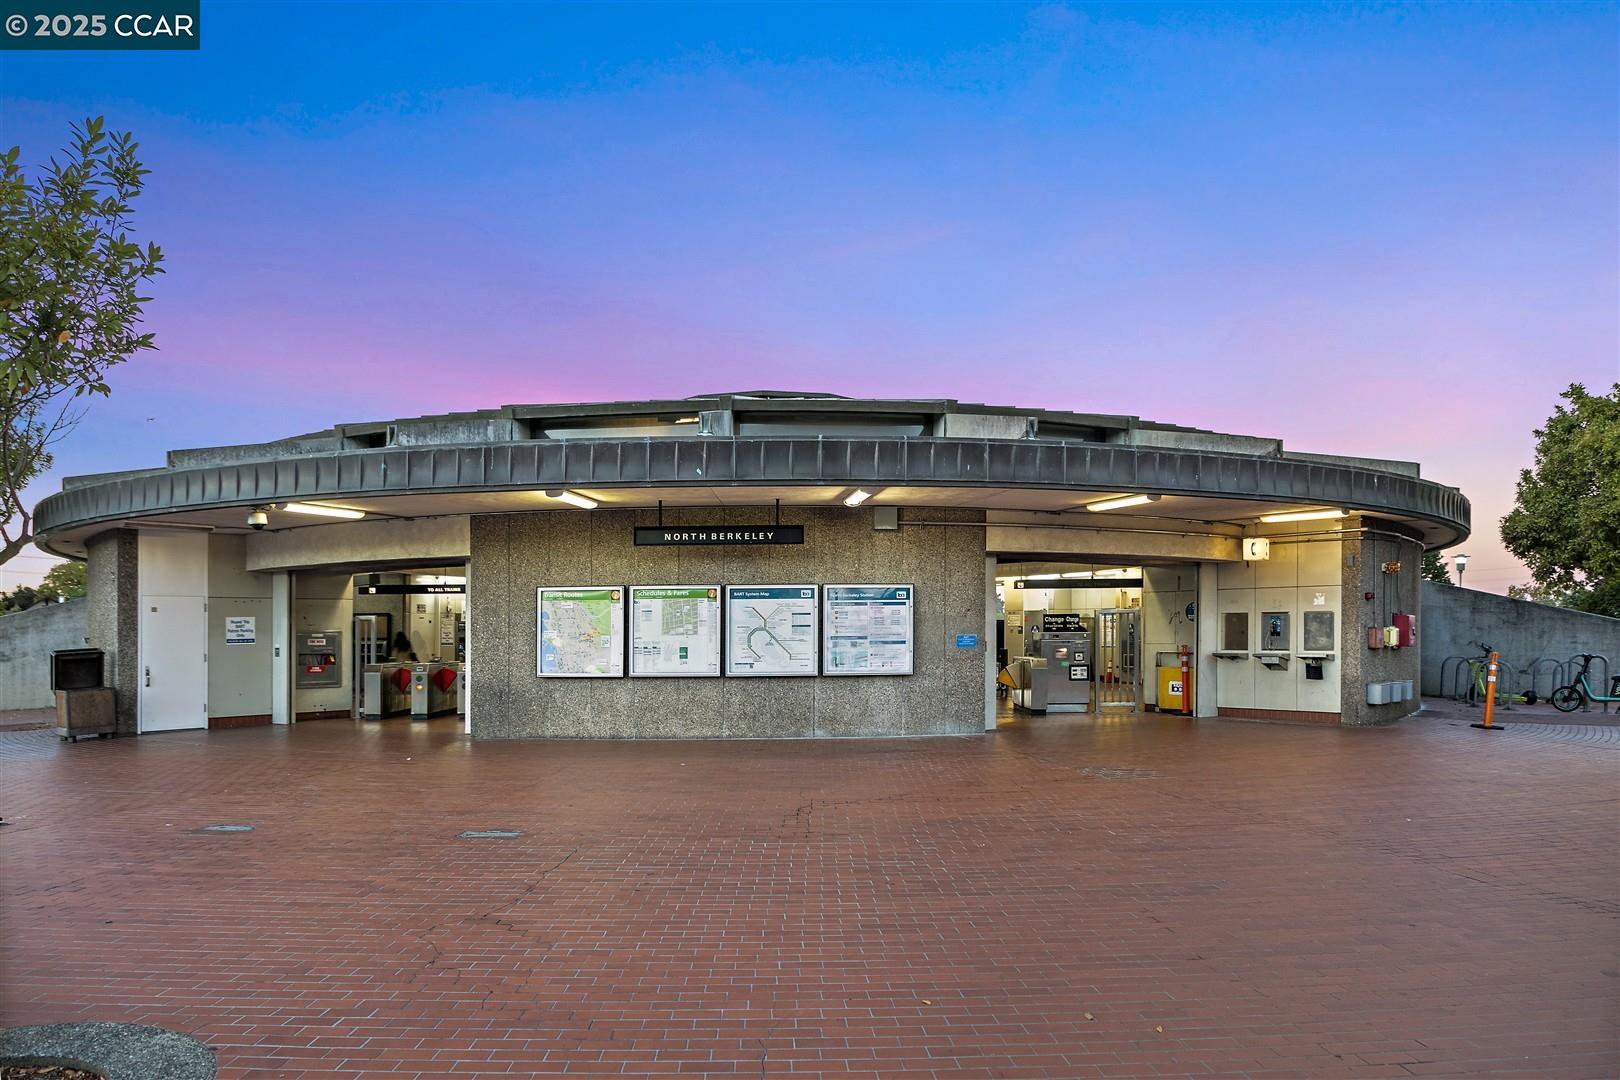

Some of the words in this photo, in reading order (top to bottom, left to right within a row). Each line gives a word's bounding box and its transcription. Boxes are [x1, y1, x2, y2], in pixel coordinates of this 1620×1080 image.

[664, 533, 707, 541] NORTH
[711, 532, 774, 540] BERKELEY
[636, 589, 666, 597] Schedules
[1044, 616, 1065, 624] Change
